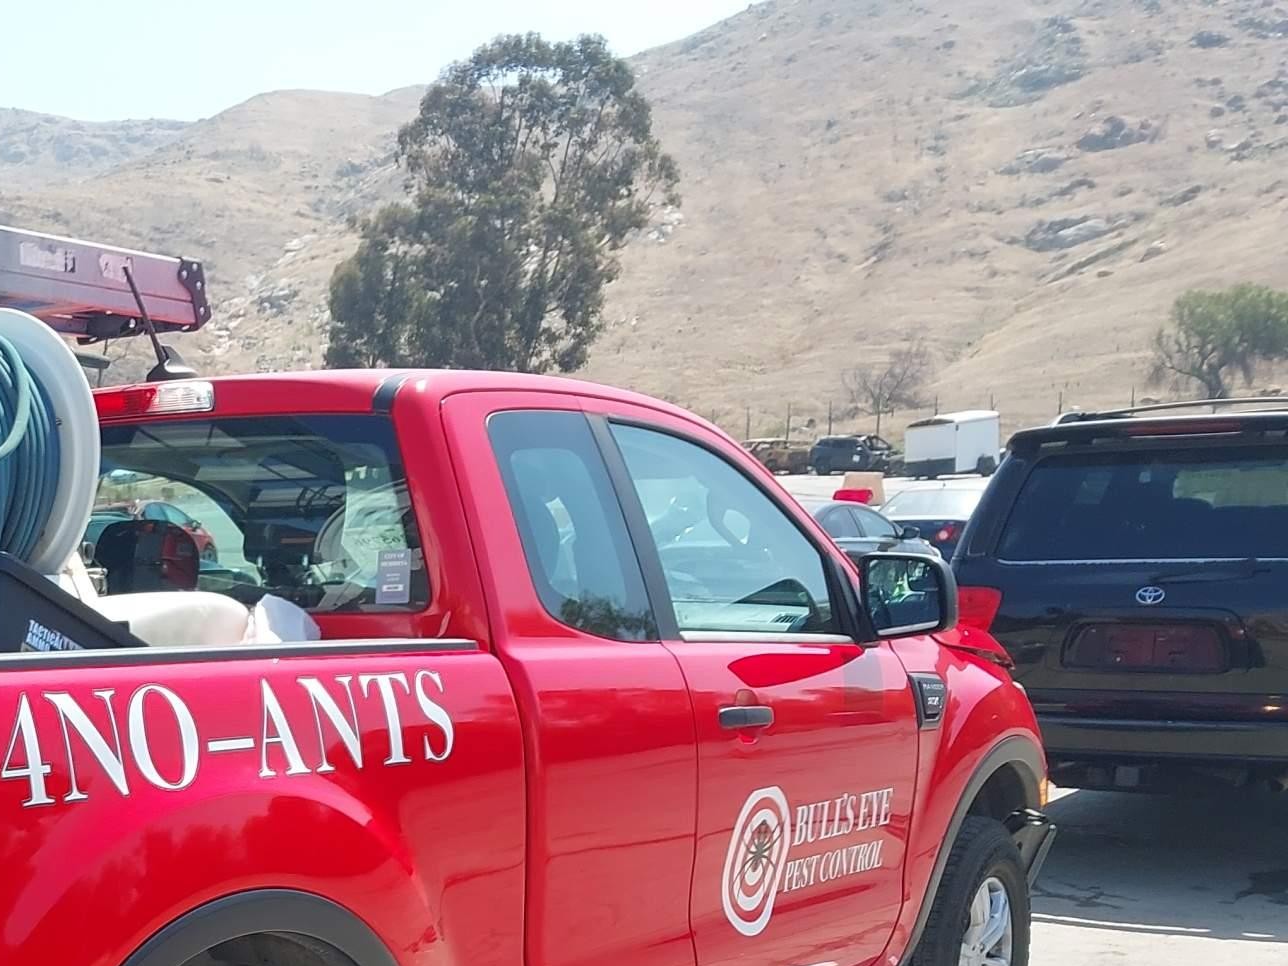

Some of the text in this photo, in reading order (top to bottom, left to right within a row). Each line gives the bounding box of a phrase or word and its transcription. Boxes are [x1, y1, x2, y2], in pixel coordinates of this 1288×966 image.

[792, 787, 894, 846] BULL'S EYE
[783, 840, 884, 893] PEST CONTROL
